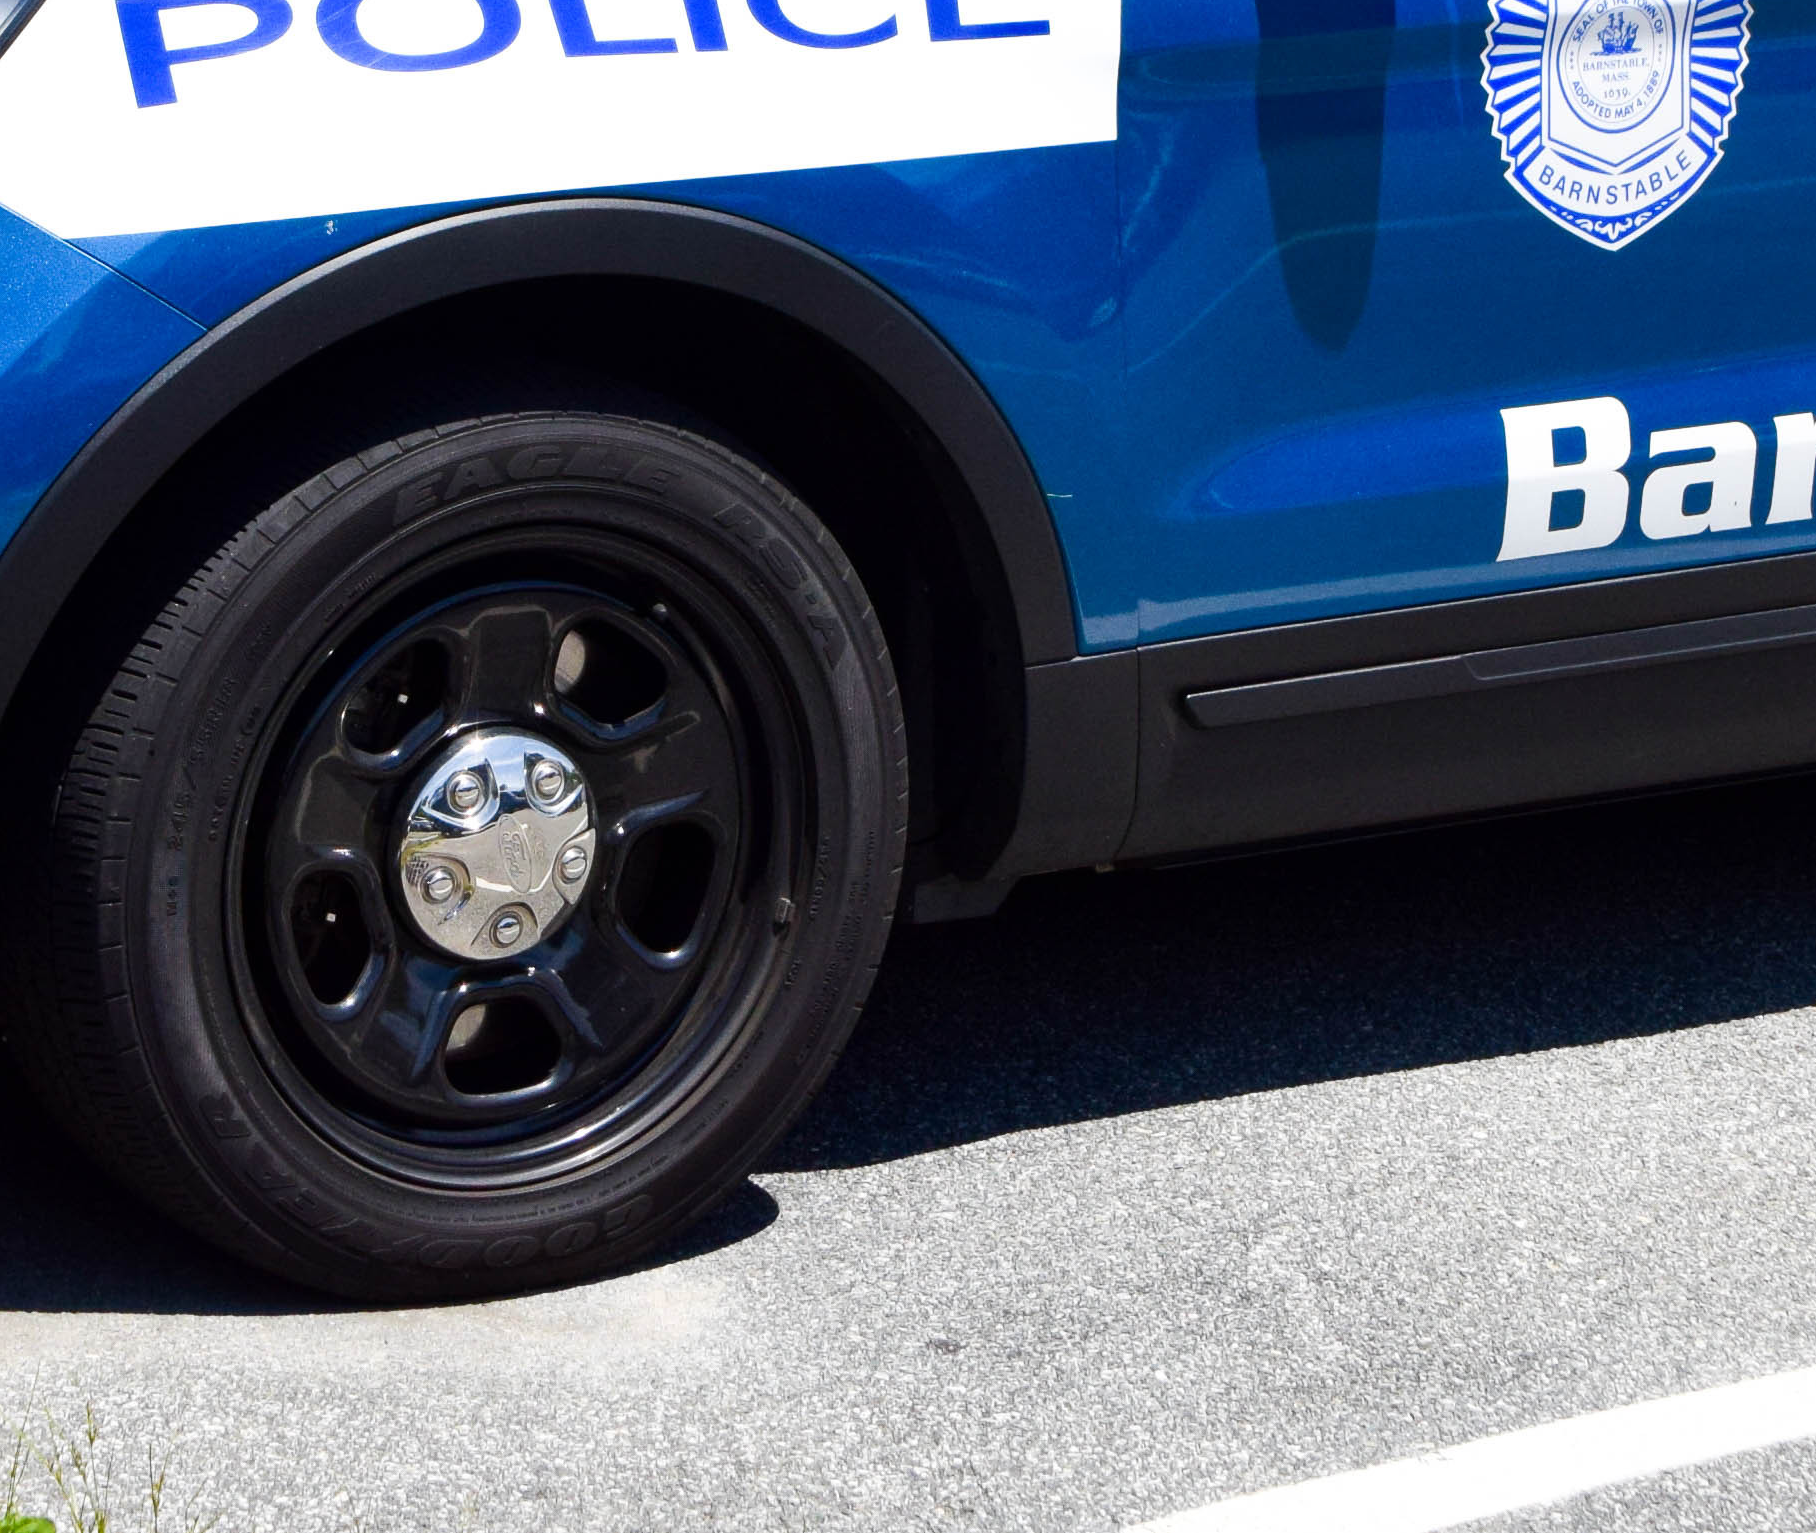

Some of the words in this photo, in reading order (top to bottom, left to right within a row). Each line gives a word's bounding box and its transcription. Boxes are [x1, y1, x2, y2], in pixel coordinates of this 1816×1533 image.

[1573, 13, 1595, 43] SEAL
[1596, 0, 1608, 14] OF
[1654, 19, 1664, 35] OF
[1572, 80, 1612, 118] ADOPTED
[1615, 103, 1634, 119] MAY
[1643, 70, 1660, 98] 1889
[1539, 150, 1691, 205] BARNSTABLE
[391, 444, 682, 526] EAGLE
[198, 1094, 654, 1271] GOODYEAR
